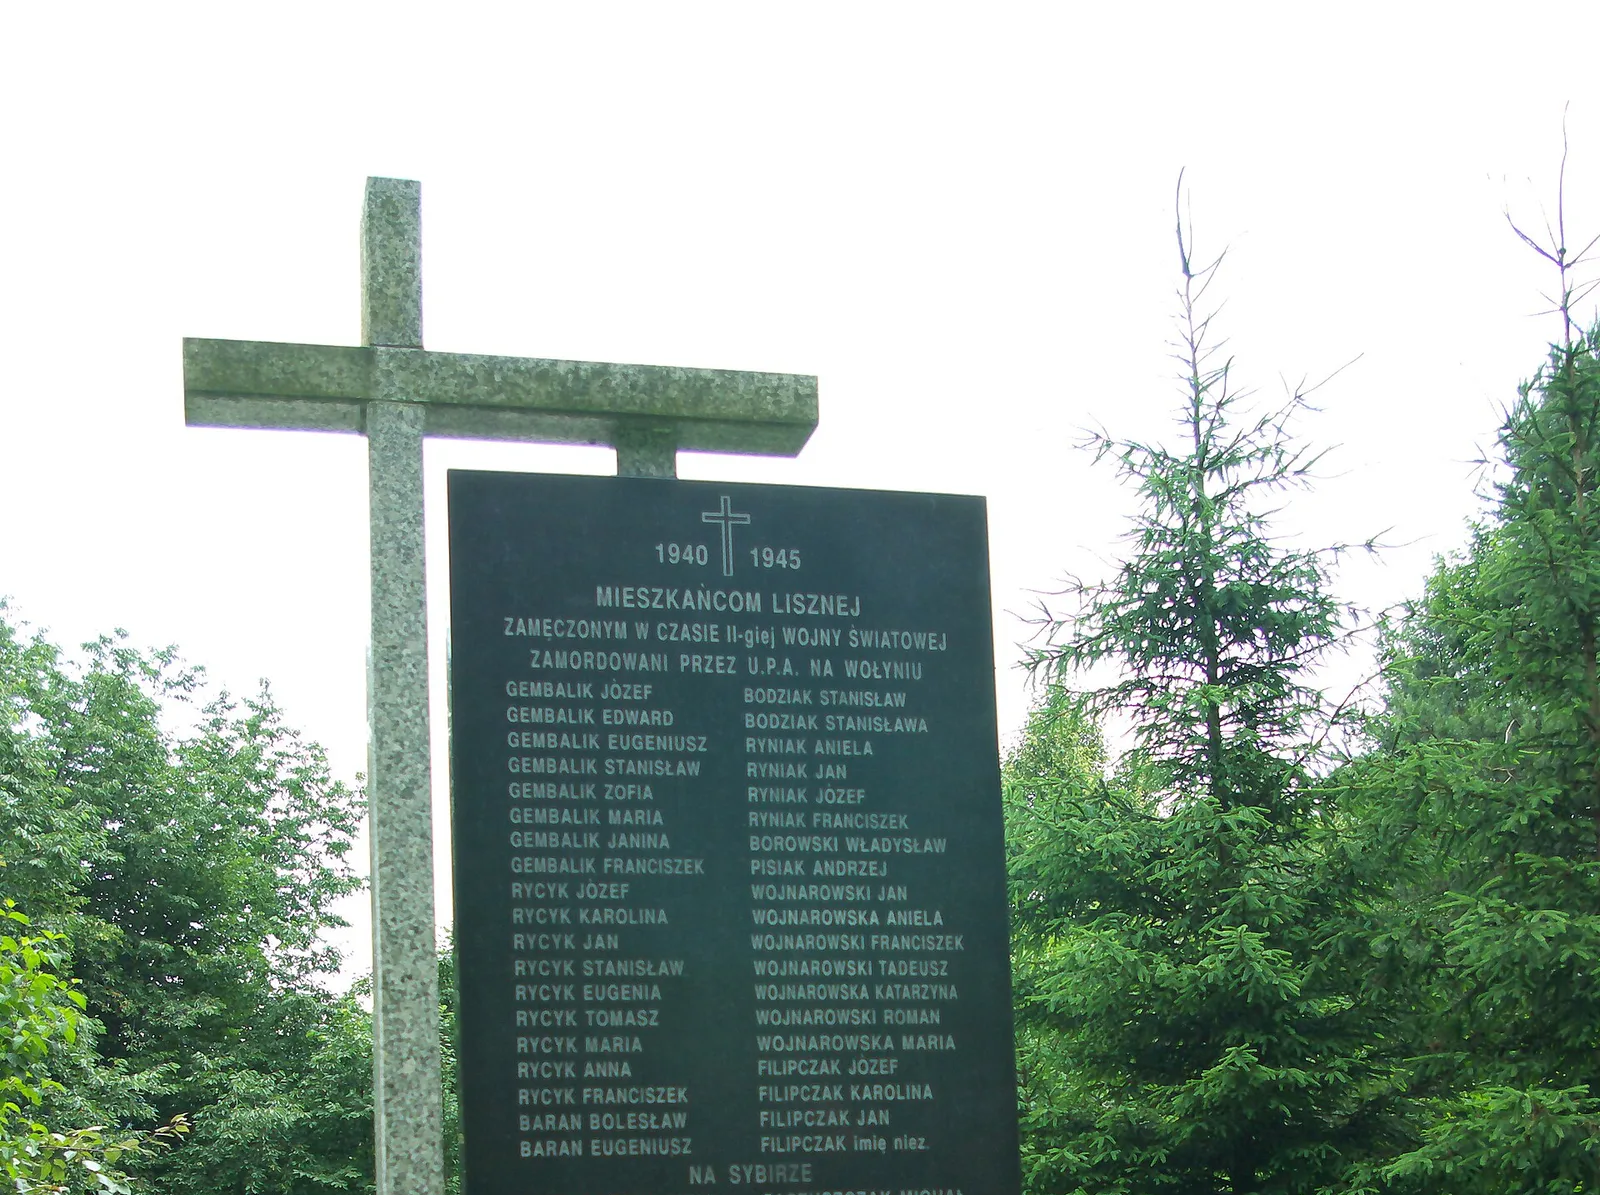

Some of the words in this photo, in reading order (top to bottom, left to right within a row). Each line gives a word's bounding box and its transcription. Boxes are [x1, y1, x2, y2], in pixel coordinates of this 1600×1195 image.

[655, 543, 708, 566] 1940
[750, 547, 801, 570] 1945
[773, 595, 860, 617] LISZNEJ
[503, 617, 627, 643] ZAMĘCZONYM
[635, 622, 649, 640] W
[657, 623, 719, 644] CZASIE
[726, 625, 775, 648] II-giej
[783, 628, 841, 648] WOJNY
[531, 650, 668, 672] ZAMORDOWANI
[680, 655, 736, 674] PRZEZ
[748, 658, 798, 676] U.P.A.
[811, 659, 832, 677] NA
[844, 661, 922, 680] WOŁYNIU
[506, 682, 593, 699] GEMBALIK
[744, 688, 812, 705] BODZIAK
[820, 690, 906, 707] STANISŁAW
[507, 707, 595, 725] GEMBALIK
[603, 709, 673, 726] EDWARD
[745, 714, 817, 731] BODZIAK
[825, 715, 928, 733] STANISŁAWA
[508, 733, 600, 750] GEMBALIK
[608, 735, 707, 752] EUGENIUSZ
[746, 738, 806, 755] RYNIAK
[814, 739, 873, 756] ANIELA
[508, 758, 597, 774] GEMBALIK
[604, 759, 701, 777] STANISŁAW
[747, 762, 807, 779] RYNIAK
[816, 763, 847, 780] JAN
[508, 783, 596, 799] GEMBALIK
[604, 784, 653, 800] ZOFIA
[748, 787, 807, 803] RYNIAK
[510, 808, 600, 824] GEMBALIK
[608, 809, 663, 826] MARIA
[749, 812, 806, 828] RYNIAK
[813, 812, 908, 830] FRANCISZEK
[510, 832, 600, 848] GEMBALIK
[608, 832, 670, 849] JANINA
[749, 836, 838, 852] BOROWSKI
[846, 837, 946, 853] WŁADYSŁAW
[511, 858, 596, 874] GEMBALIK
[604, 859, 704, 875] FRANCISZEK
[750, 860, 804, 876] PISIAK
[812, 860, 887, 877] ANDRZEJ
[512, 883, 569, 899] RYCYK
[751, 884, 871, 902] WOJNAROWSKI
[878, 885, 907, 902] JAN
[512, 908, 570, 925] RYCYK
[579, 908, 668, 925] KAROLINA
[752, 909, 880, 926] WOJNAROWSKA
[886, 910, 943, 926] ANIELA
[513, 933, 575, 950] RYCYK
[583, 933, 619, 950] JAN
[751, 934, 865, 951] WOJNAROWSKI
[871, 934, 964, 951] FRANCISZEK
[514, 959, 575, 976] RYCYK
[583, 959, 684, 976] STANISŁAW
[754, 960, 872, 977] WOJNAROWSKI
[879, 960, 948, 977] TADEUSZ
[515, 984, 575, 1001] RYCYK
[584, 984, 661, 1001] EUGENIA
[754, 984, 869, 1000] WOJNAROWSKA
[875, 984, 957, 1000] KATARZYNA
[516, 1010, 577, 1027] RYCYK
[585, 1009, 659, 1027] TOMASZ
[755, 1008, 876, 1026] WOJNAROWSKI
[884, 1008, 940, 1025] ROMAN
[517, 1036, 577, 1053] RYCYK
[585, 1036, 642, 1053] MARIA
[756, 1035, 894, 1052] WOJNAROWSKA
[901, 1034, 956, 1050] MARIA
[517, 1062, 575, 1079] RYCYK
[583, 1062, 632, 1078] ANNA
[758, 1059, 841, 1076] FILIPCZAK
[518, 1087, 575, 1105] RYCYK
[583, 1086, 688, 1104] FRANCISZEK
[759, 1085, 843, 1101] FILIPCZAK
[850, 1083, 933, 1100] KAROLINA
[519, 1114, 582, 1131] BARAN
[590, 1112, 687, 1130] BOLESŁAW
[760, 1110, 850, 1127] FILIPCZAK
[856, 1109, 889, 1126] JAN
[520, 1139, 583, 1157] BARAN
[590, 1138, 691, 1156] EUGENIUSZ
[761, 1135, 846, 1153] FILIPCZAK
[854, 1134, 887, 1154] imię
[689, 1166, 716, 1184] NA
[729, 1164, 812, 1184] SYBIRZE
